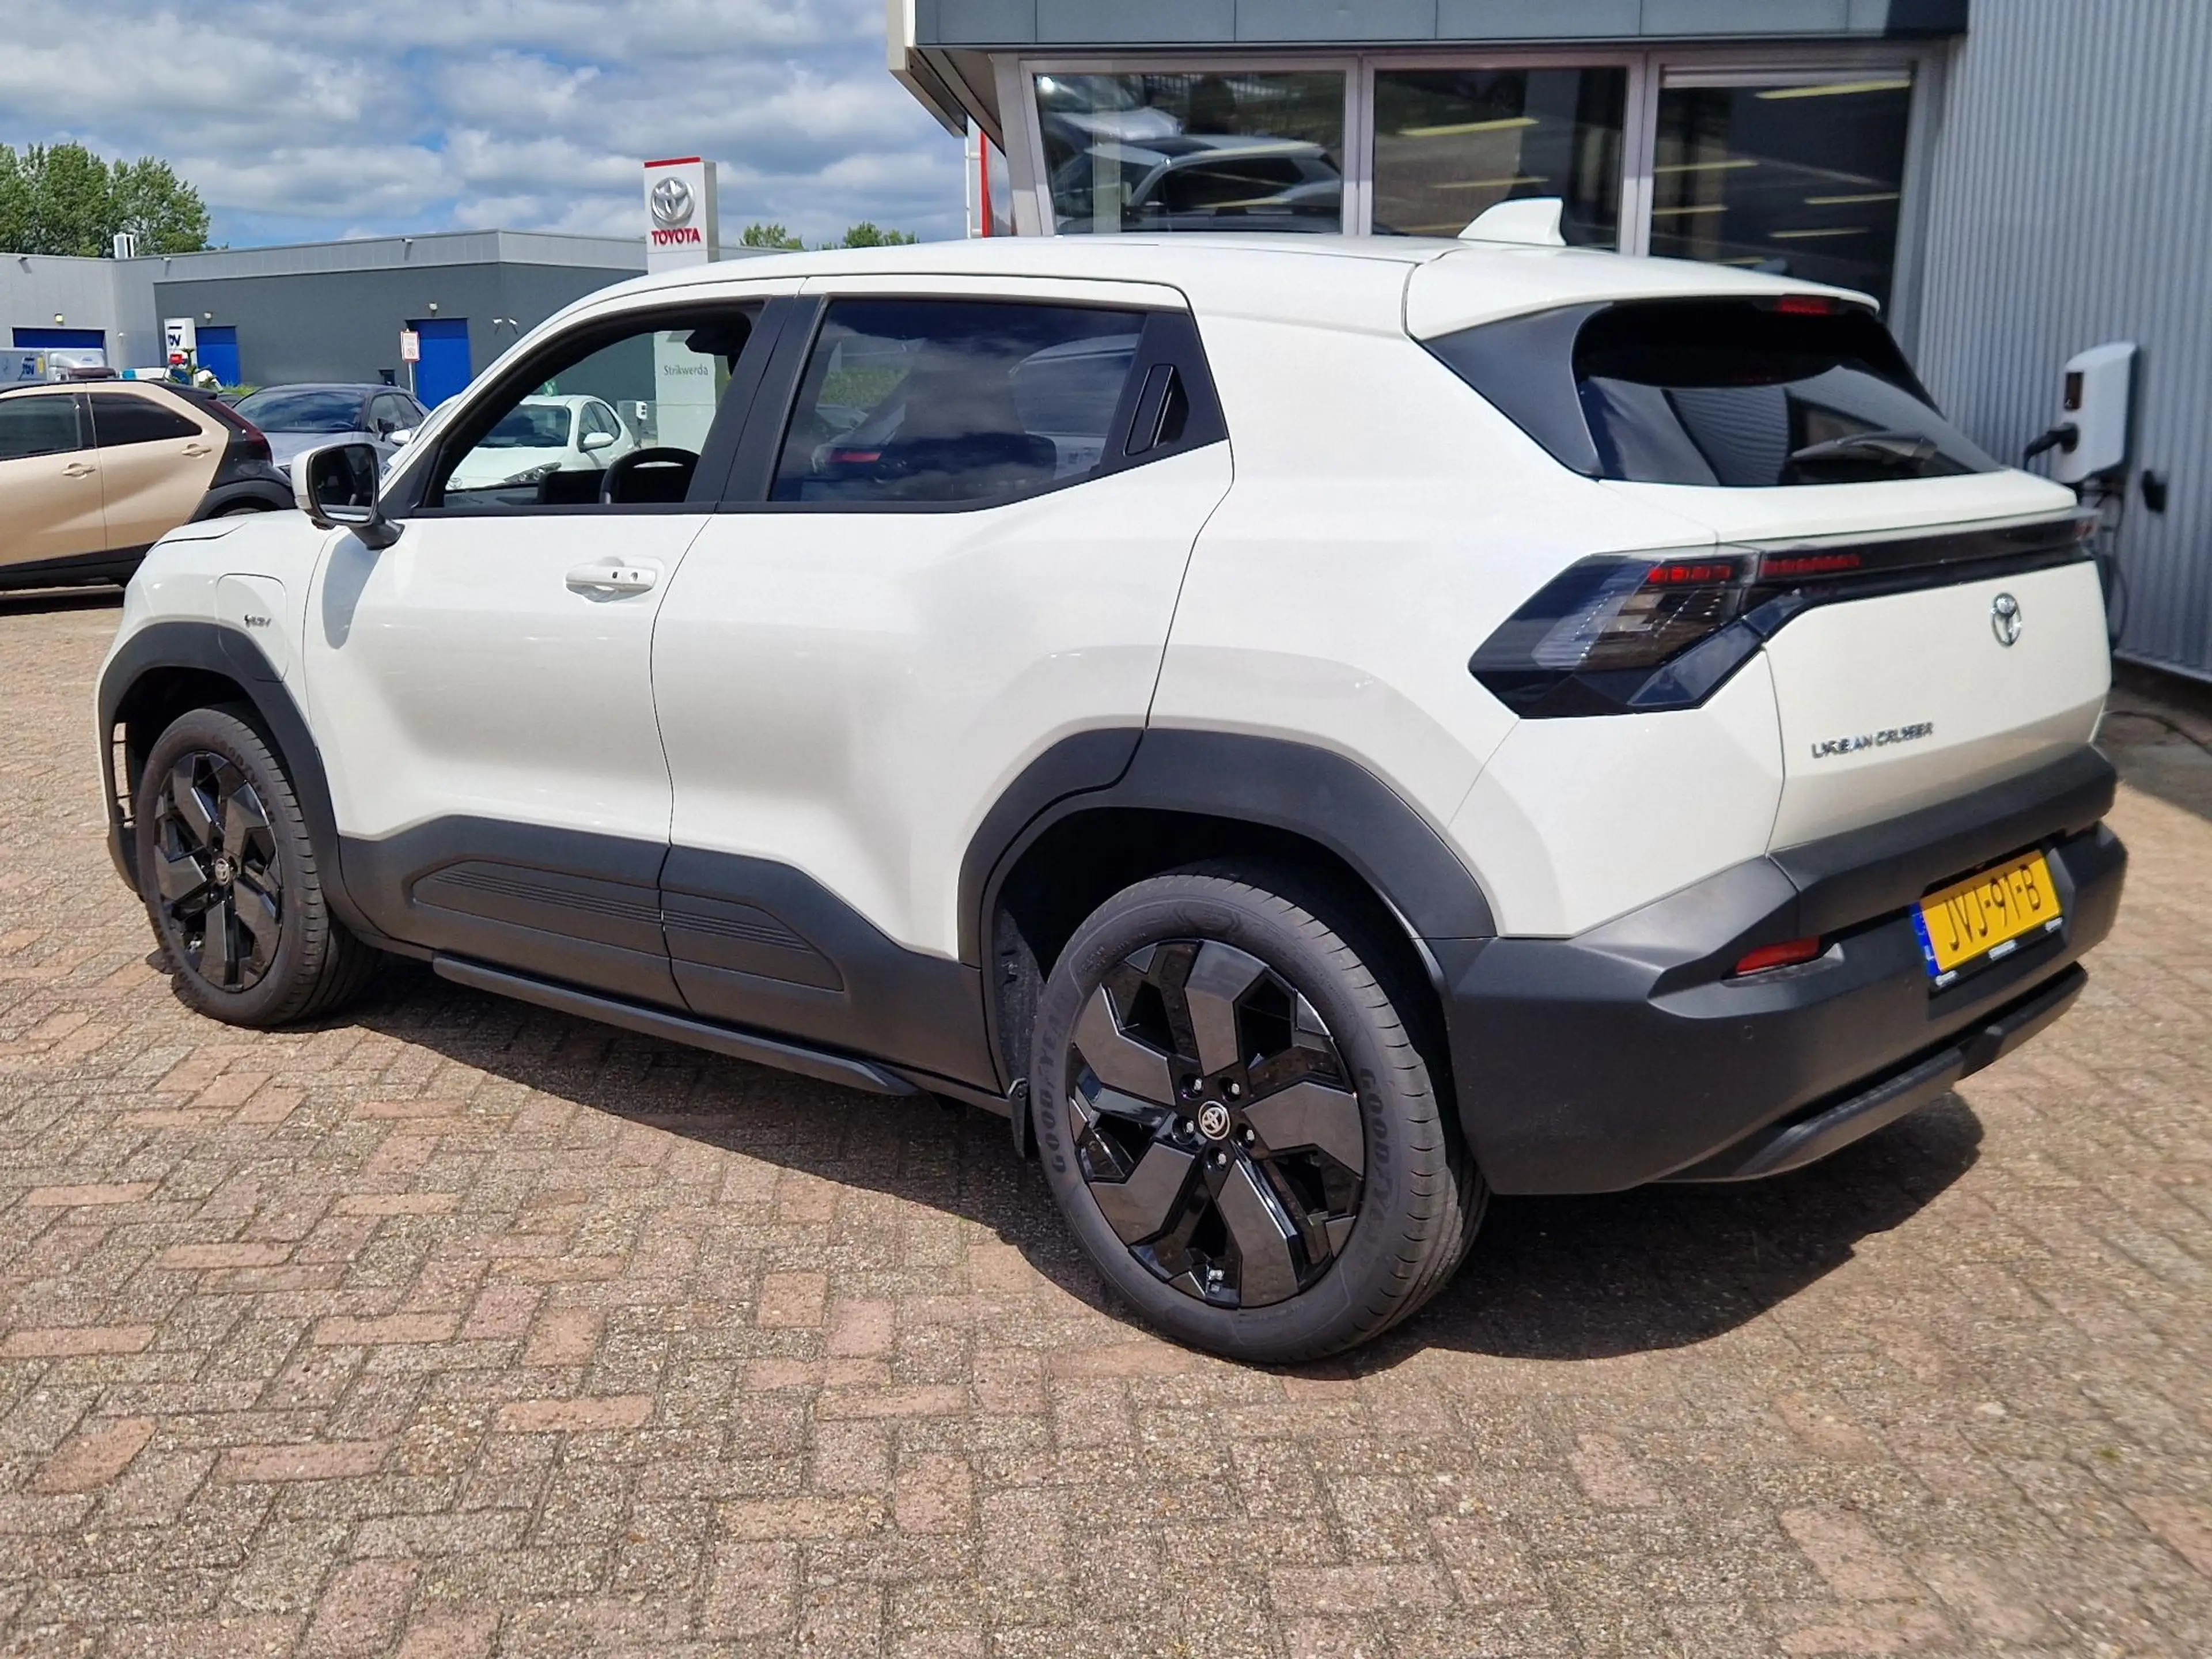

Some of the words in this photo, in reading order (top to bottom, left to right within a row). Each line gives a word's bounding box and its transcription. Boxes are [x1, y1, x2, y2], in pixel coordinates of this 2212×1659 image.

[651, 228, 701, 247] TOYOTA
[664, 363, 709, 376] Strikwerda
[1943, 863, 2041, 952] JVJ-91-B
